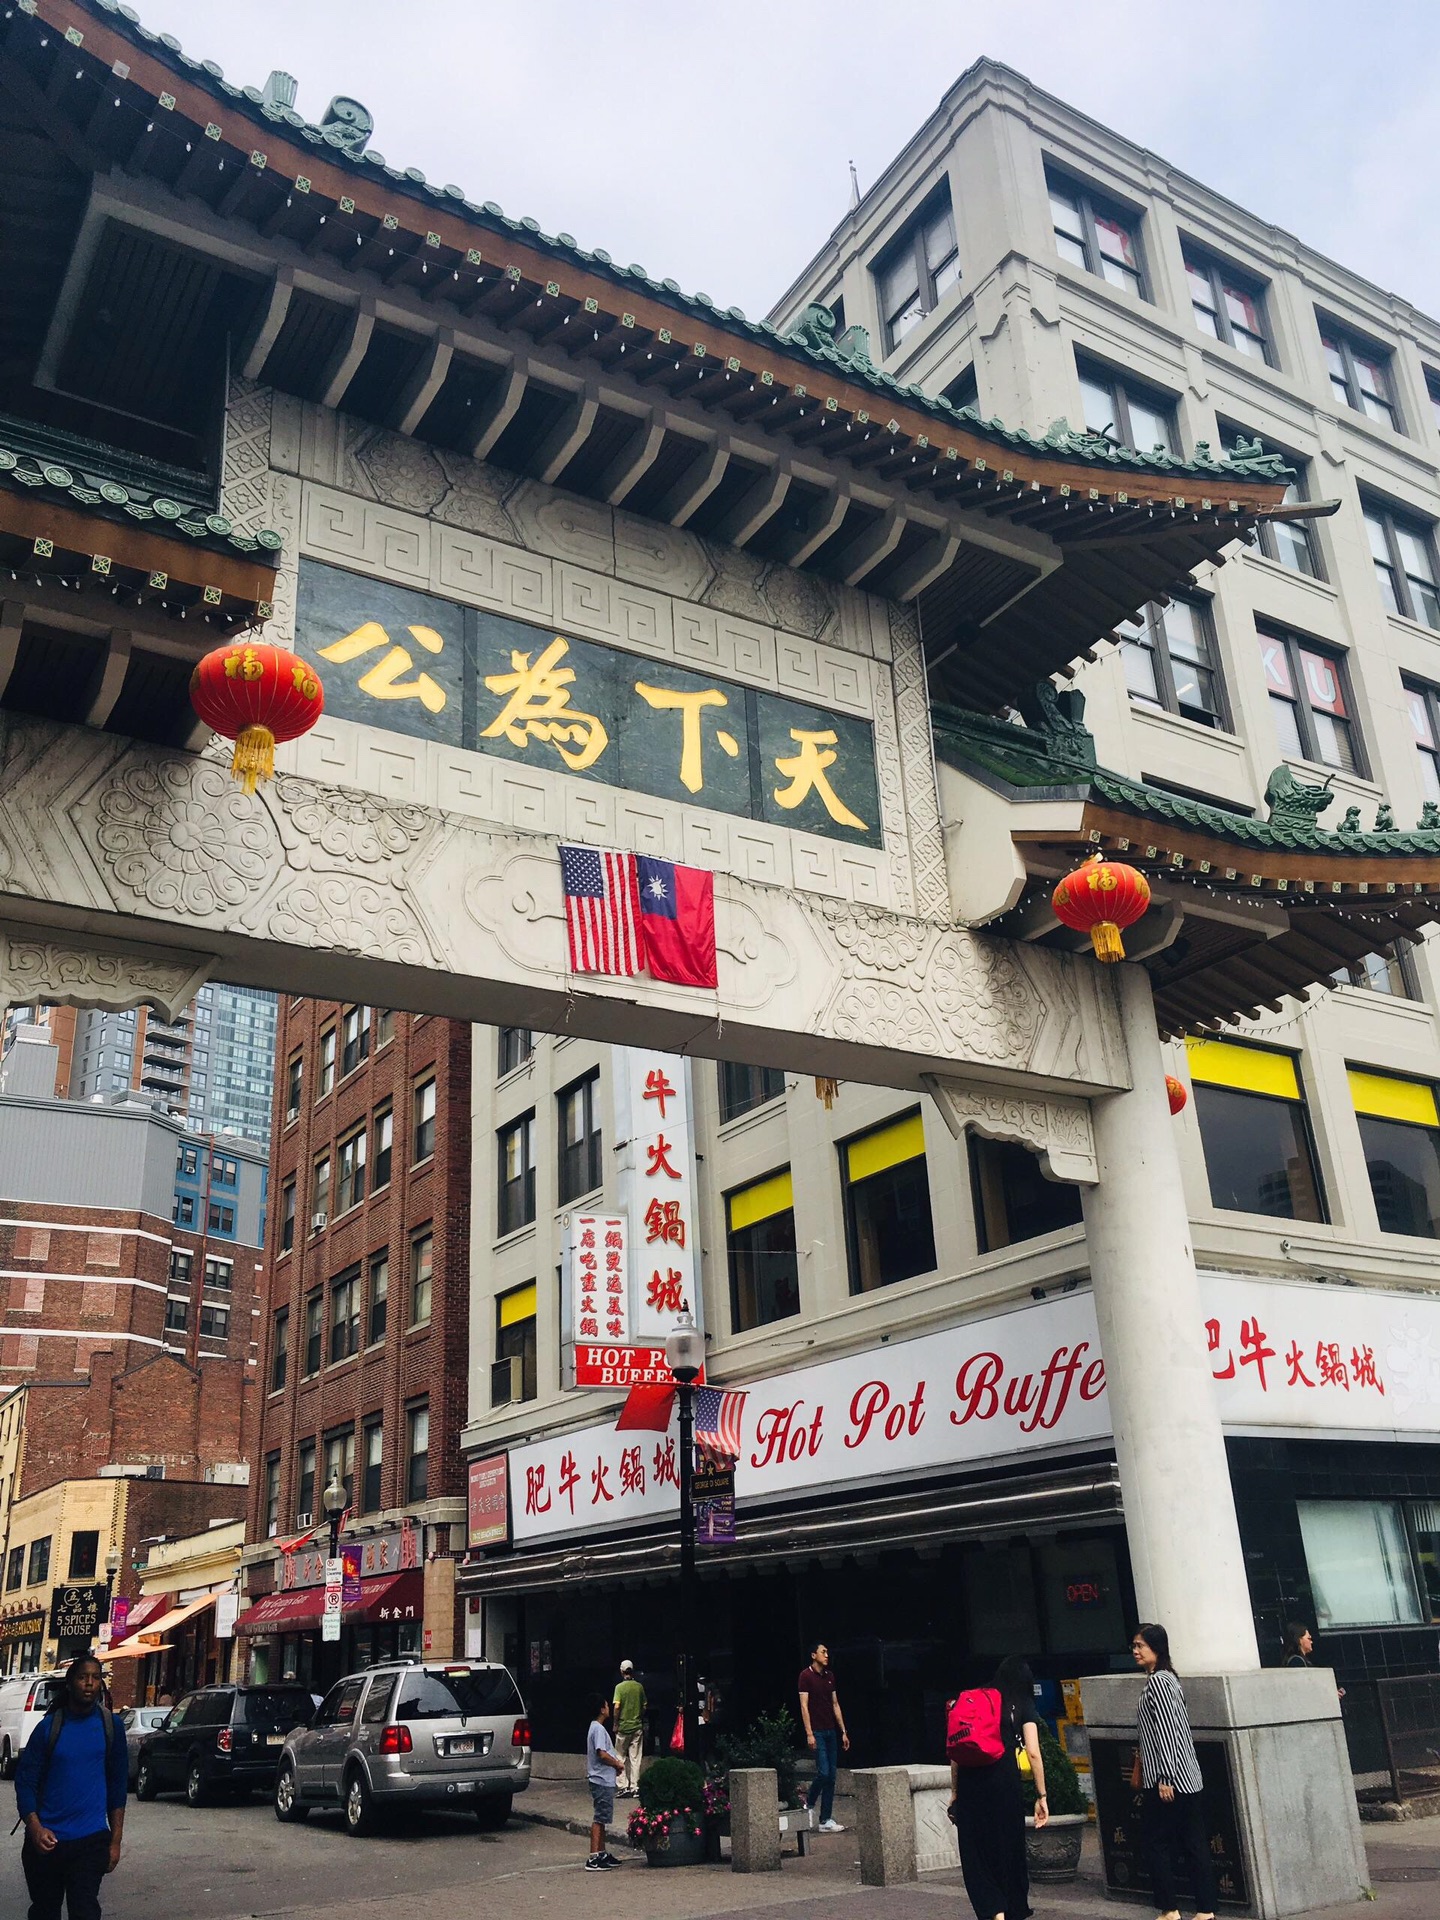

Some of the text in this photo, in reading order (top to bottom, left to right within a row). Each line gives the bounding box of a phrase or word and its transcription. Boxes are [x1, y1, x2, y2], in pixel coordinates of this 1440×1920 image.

[586, 1348, 636, 1367] HOT
[750, 1341, 1107, 1469] Hot Pot Buffe
[525, 1435, 680, 1516] 肥牛火鍋城
[1066, 1583, 1100, 1602] OPEN
[56, 1613, 97, 1626] 5 SPICES
[380, 1605, 414, 1620] 新金門
[60, 1624, 91, 1636] HOUSE
